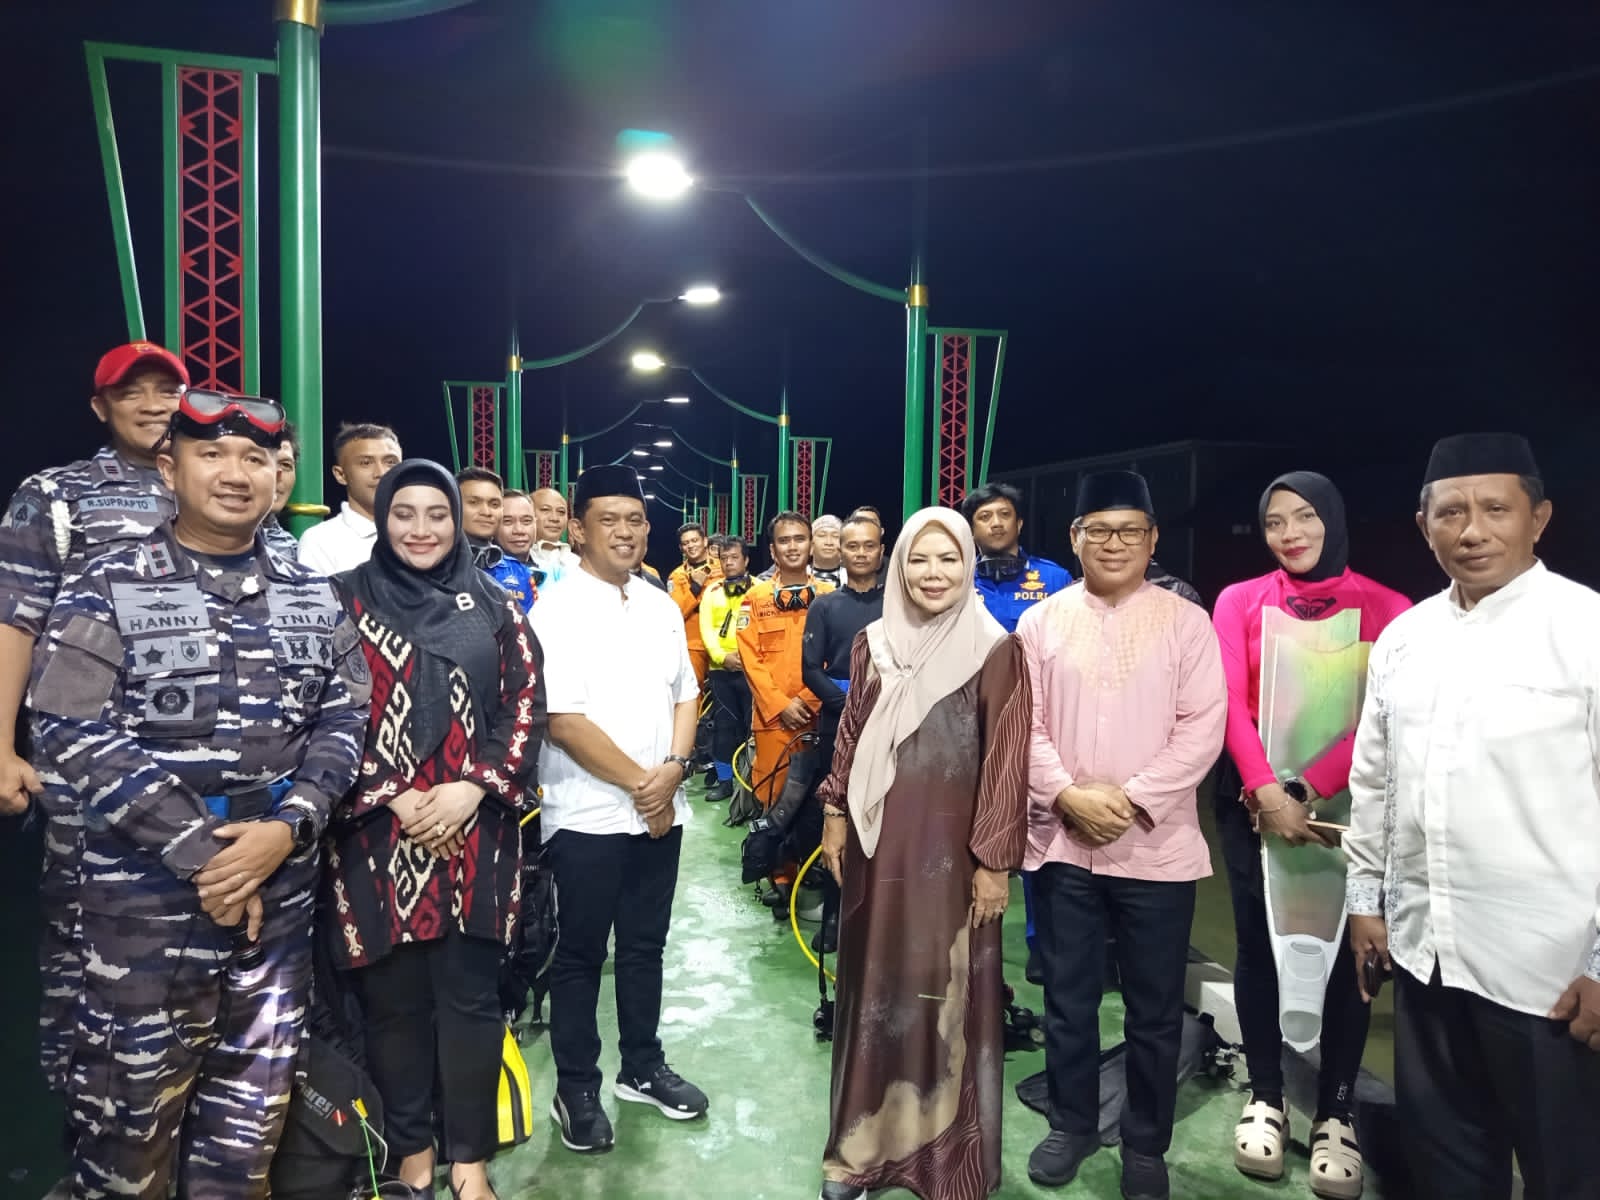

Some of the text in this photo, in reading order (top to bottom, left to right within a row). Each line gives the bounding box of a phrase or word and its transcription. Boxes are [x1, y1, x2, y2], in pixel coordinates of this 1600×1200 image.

[87, 498, 149, 510] R.SUPRAPTO
[129, 615, 199, 632] HANNY
[276, 614, 333, 628] TNI AL
